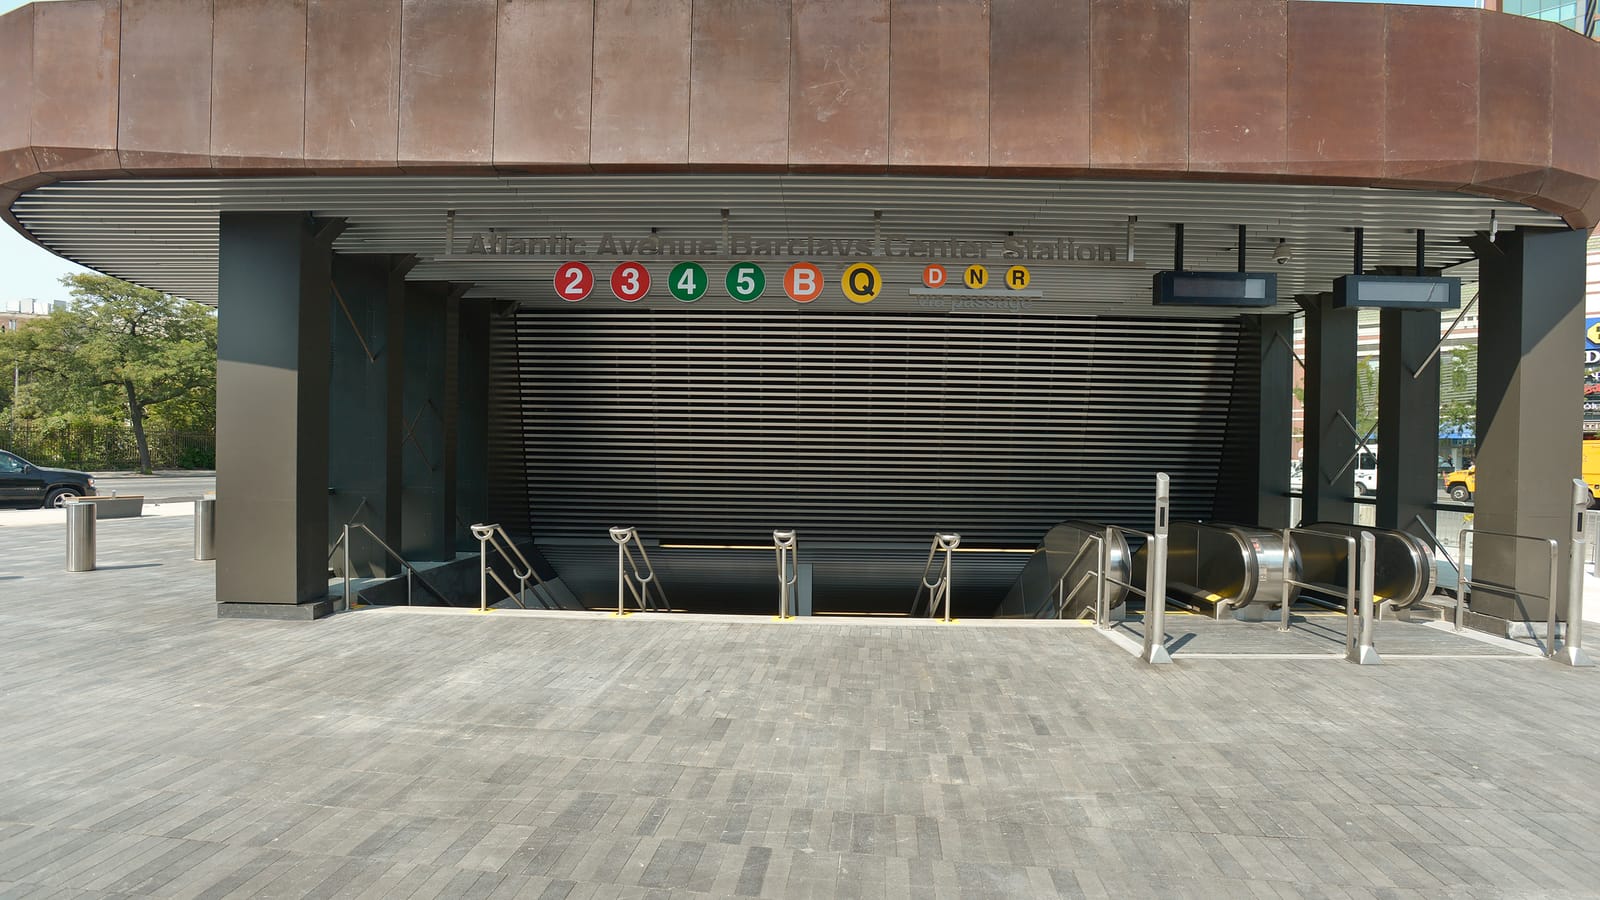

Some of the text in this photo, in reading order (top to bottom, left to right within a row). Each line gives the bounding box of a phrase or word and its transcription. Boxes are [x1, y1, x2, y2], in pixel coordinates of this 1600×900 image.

[466, 233, 1117, 261] Atlantic Avenue Barclays Center Station
[564, 267, 875, 297] 2 3 4 5 B Q
[928, 268, 1025, 285] D N R
